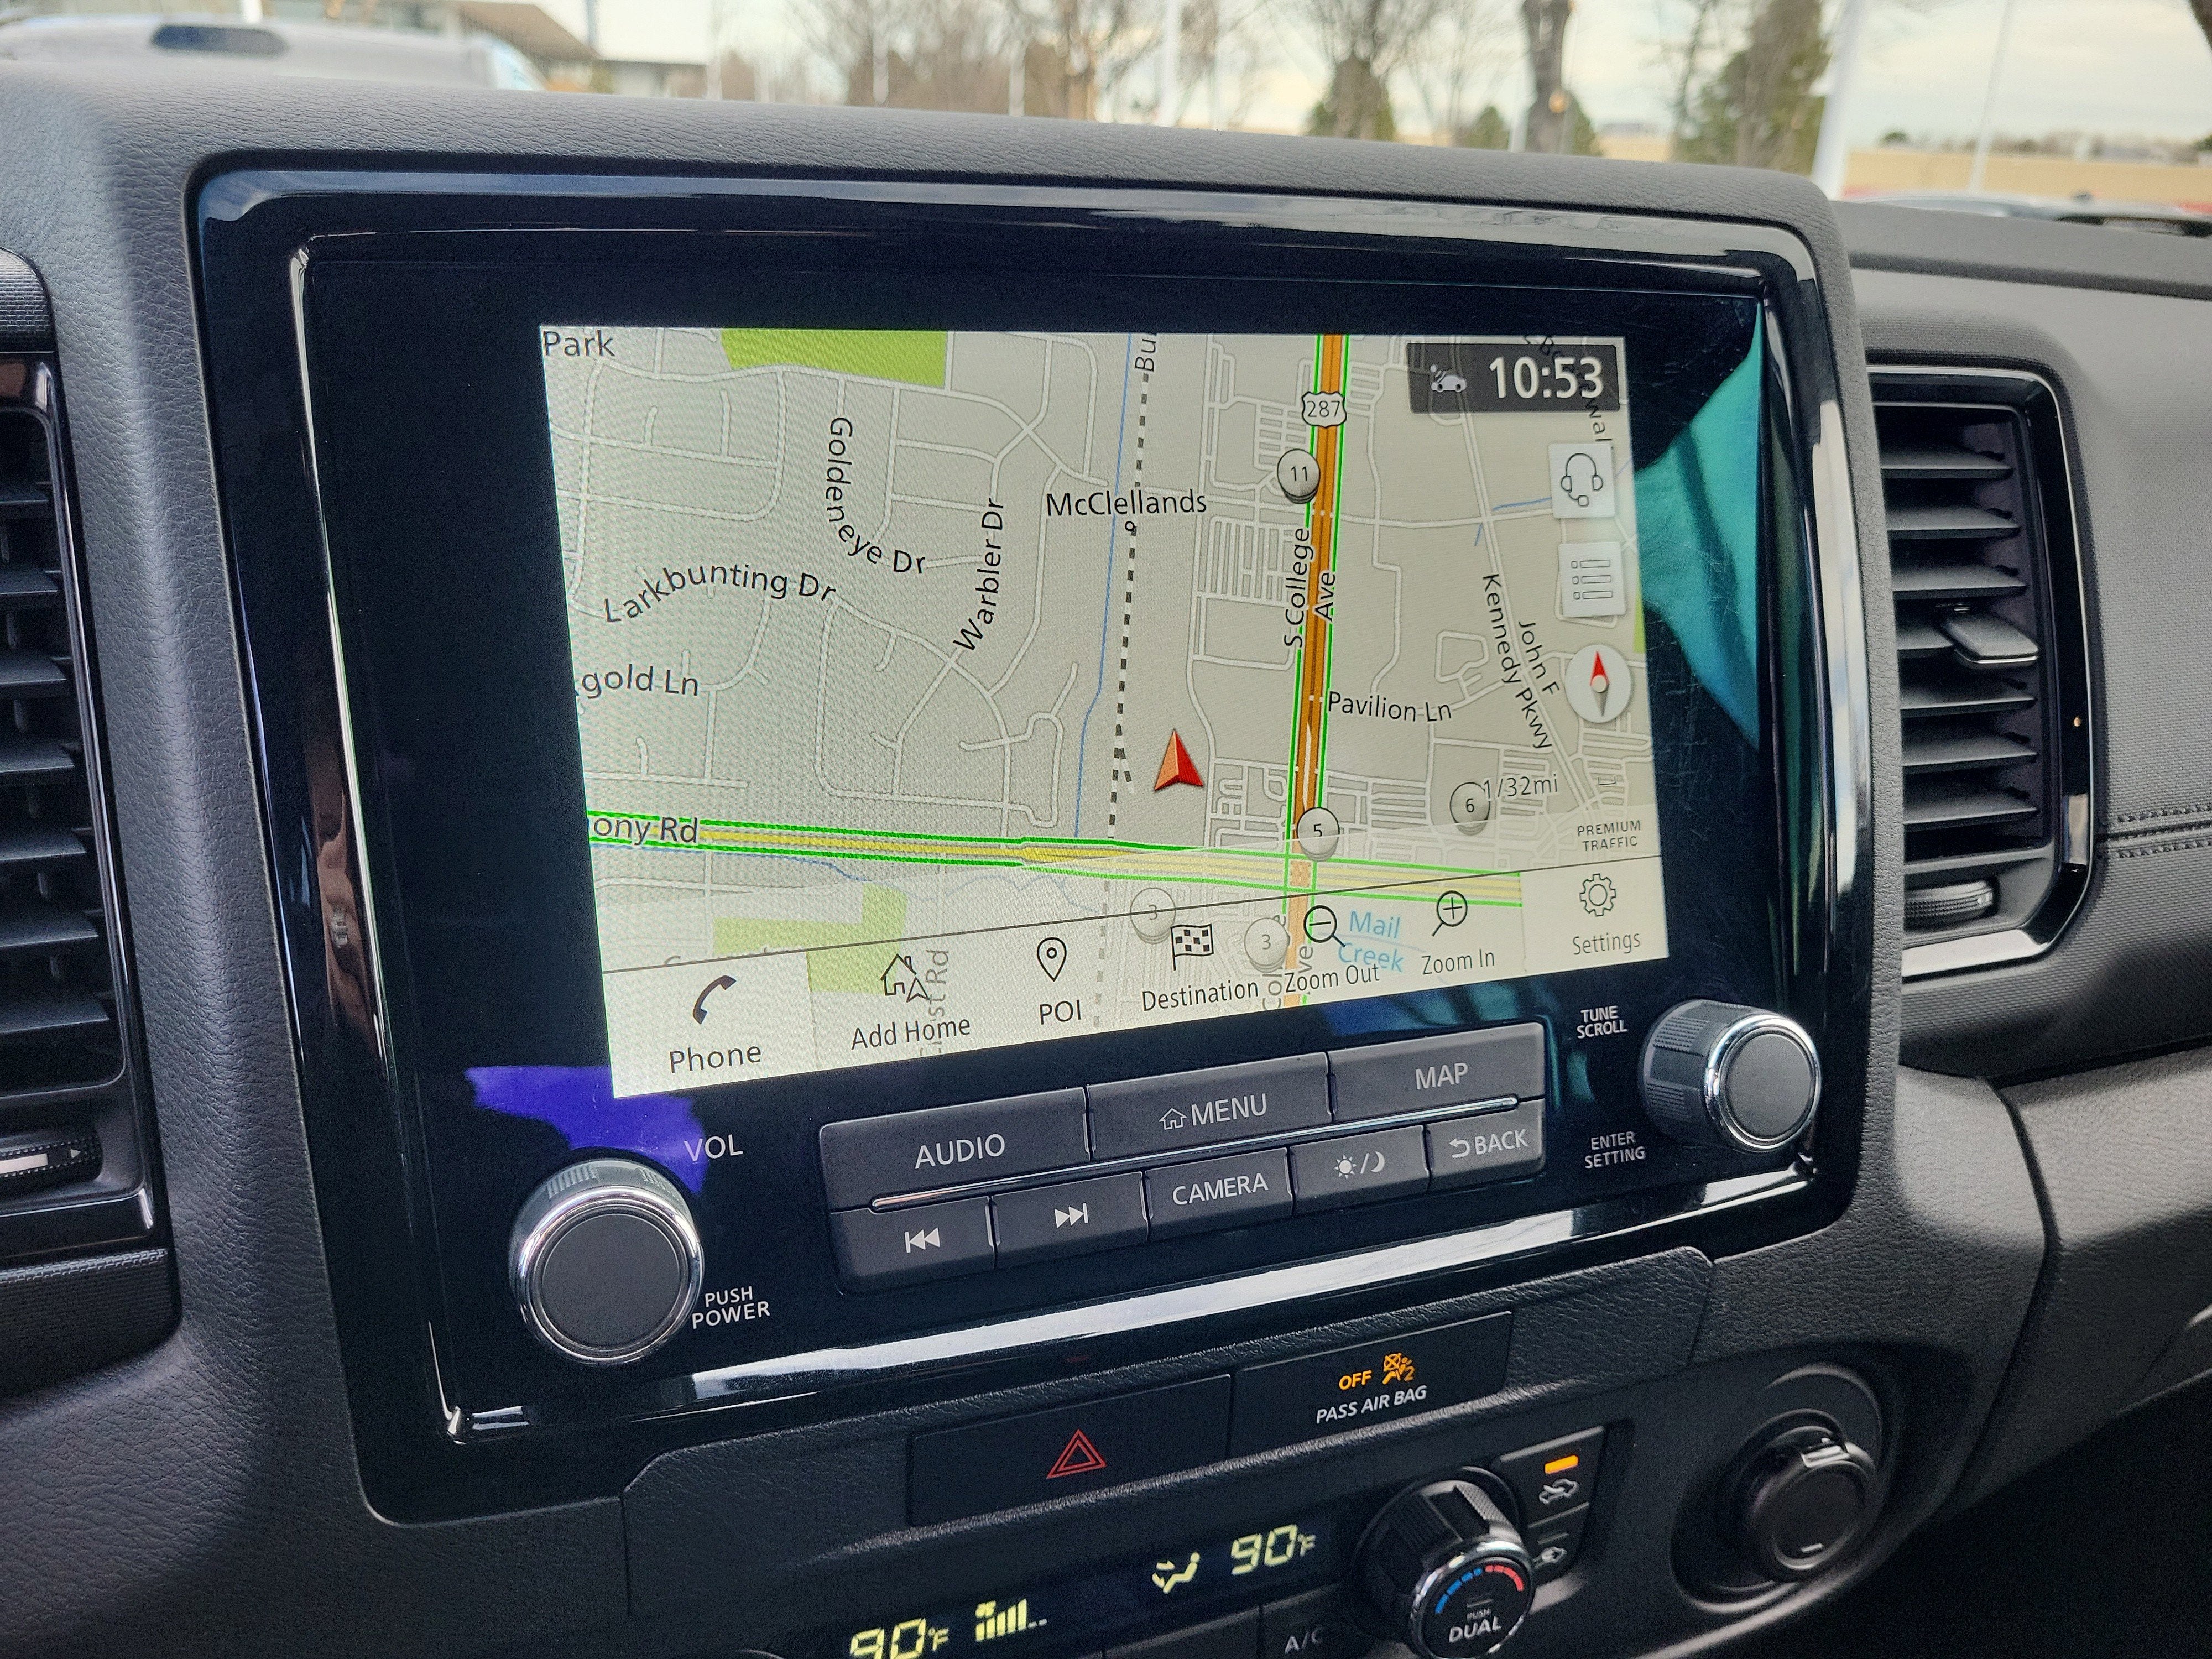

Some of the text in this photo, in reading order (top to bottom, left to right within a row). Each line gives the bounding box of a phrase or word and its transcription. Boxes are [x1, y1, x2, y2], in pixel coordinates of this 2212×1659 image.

[542, 330, 616, 357] Park
[1135, 333, 1156, 372] Bu
[1489, 356, 1603, 399] 10:53
[1307, 399, 1340, 419] 287
[1290, 466, 1308, 482] 11
[825, 416, 926, 575] Goldeneye Dr
[1046, 489, 1207, 517] McClellands
[953, 498, 1004, 651] Warbler Dr
[1284, 527, 1314, 647] S College
[604, 564, 836, 623] Larkbunting Dr
[1314, 571, 1336, 622] Ave
[1483, 573, 1552, 748] Kennedy Pkwy
[1519, 621, 1559, 694] John F
[581, 663, 698, 700] gold Ln
[1328, 691, 1452, 722] Pavilion Ln
[1483, 773, 1558, 799] 1/32mi
[1465, 797, 1475, 813] 6
[593, 817, 697, 845] ony Rd
[1313, 823, 1323, 838] 5
[1578, 820, 1640, 837] PREMIUM
[1583, 836, 1637, 852] TRAFFIC
[1147, 904, 1157, 921] 3
[1349, 910, 1401, 940] Mail
[1261, 933, 1271, 950] 3
[1572, 931, 1641, 956] Settings
[925, 950, 948, 984] Rd
[1298, 946, 1313, 995] ve
[1338, 943, 1403, 972] Creek
[1421, 948, 1495, 975] Zoom In
[1284, 962, 1380, 993] Zoom Out
[1142, 979, 1259, 1011] Destination
[1039, 999, 1082, 1026] POI
[1580, 1005, 1619, 1022] TUNE
[851, 1019, 971, 1051] Add Home
[1577, 1018, 1627, 1039] SCROLL
[669, 1044, 761, 1074] Phone
[1415, 1062, 1469, 1091] MAP
[1191, 1093, 1267, 1128] MENU
[684, 1134, 743, 1162] VOL
[915, 1134, 1005, 1170] AUDIO
[1473, 1128, 1529, 1157] BACK
[1590, 1131, 1635, 1150] ENTER
[1585, 1146, 1645, 1168] SETTING
[1172, 1172, 1269, 1207] CAMERA
[705, 1286, 753, 1307] PUSH
[692, 1300, 770, 1330] POWER
[1339, 1370, 1372, 1390] OFF
[1316, 1385, 1427, 1424] PASS AIR BAG
[1284, 1626, 1324, 1655] A/C
[1448, 1616, 1501, 1644] DUAL
